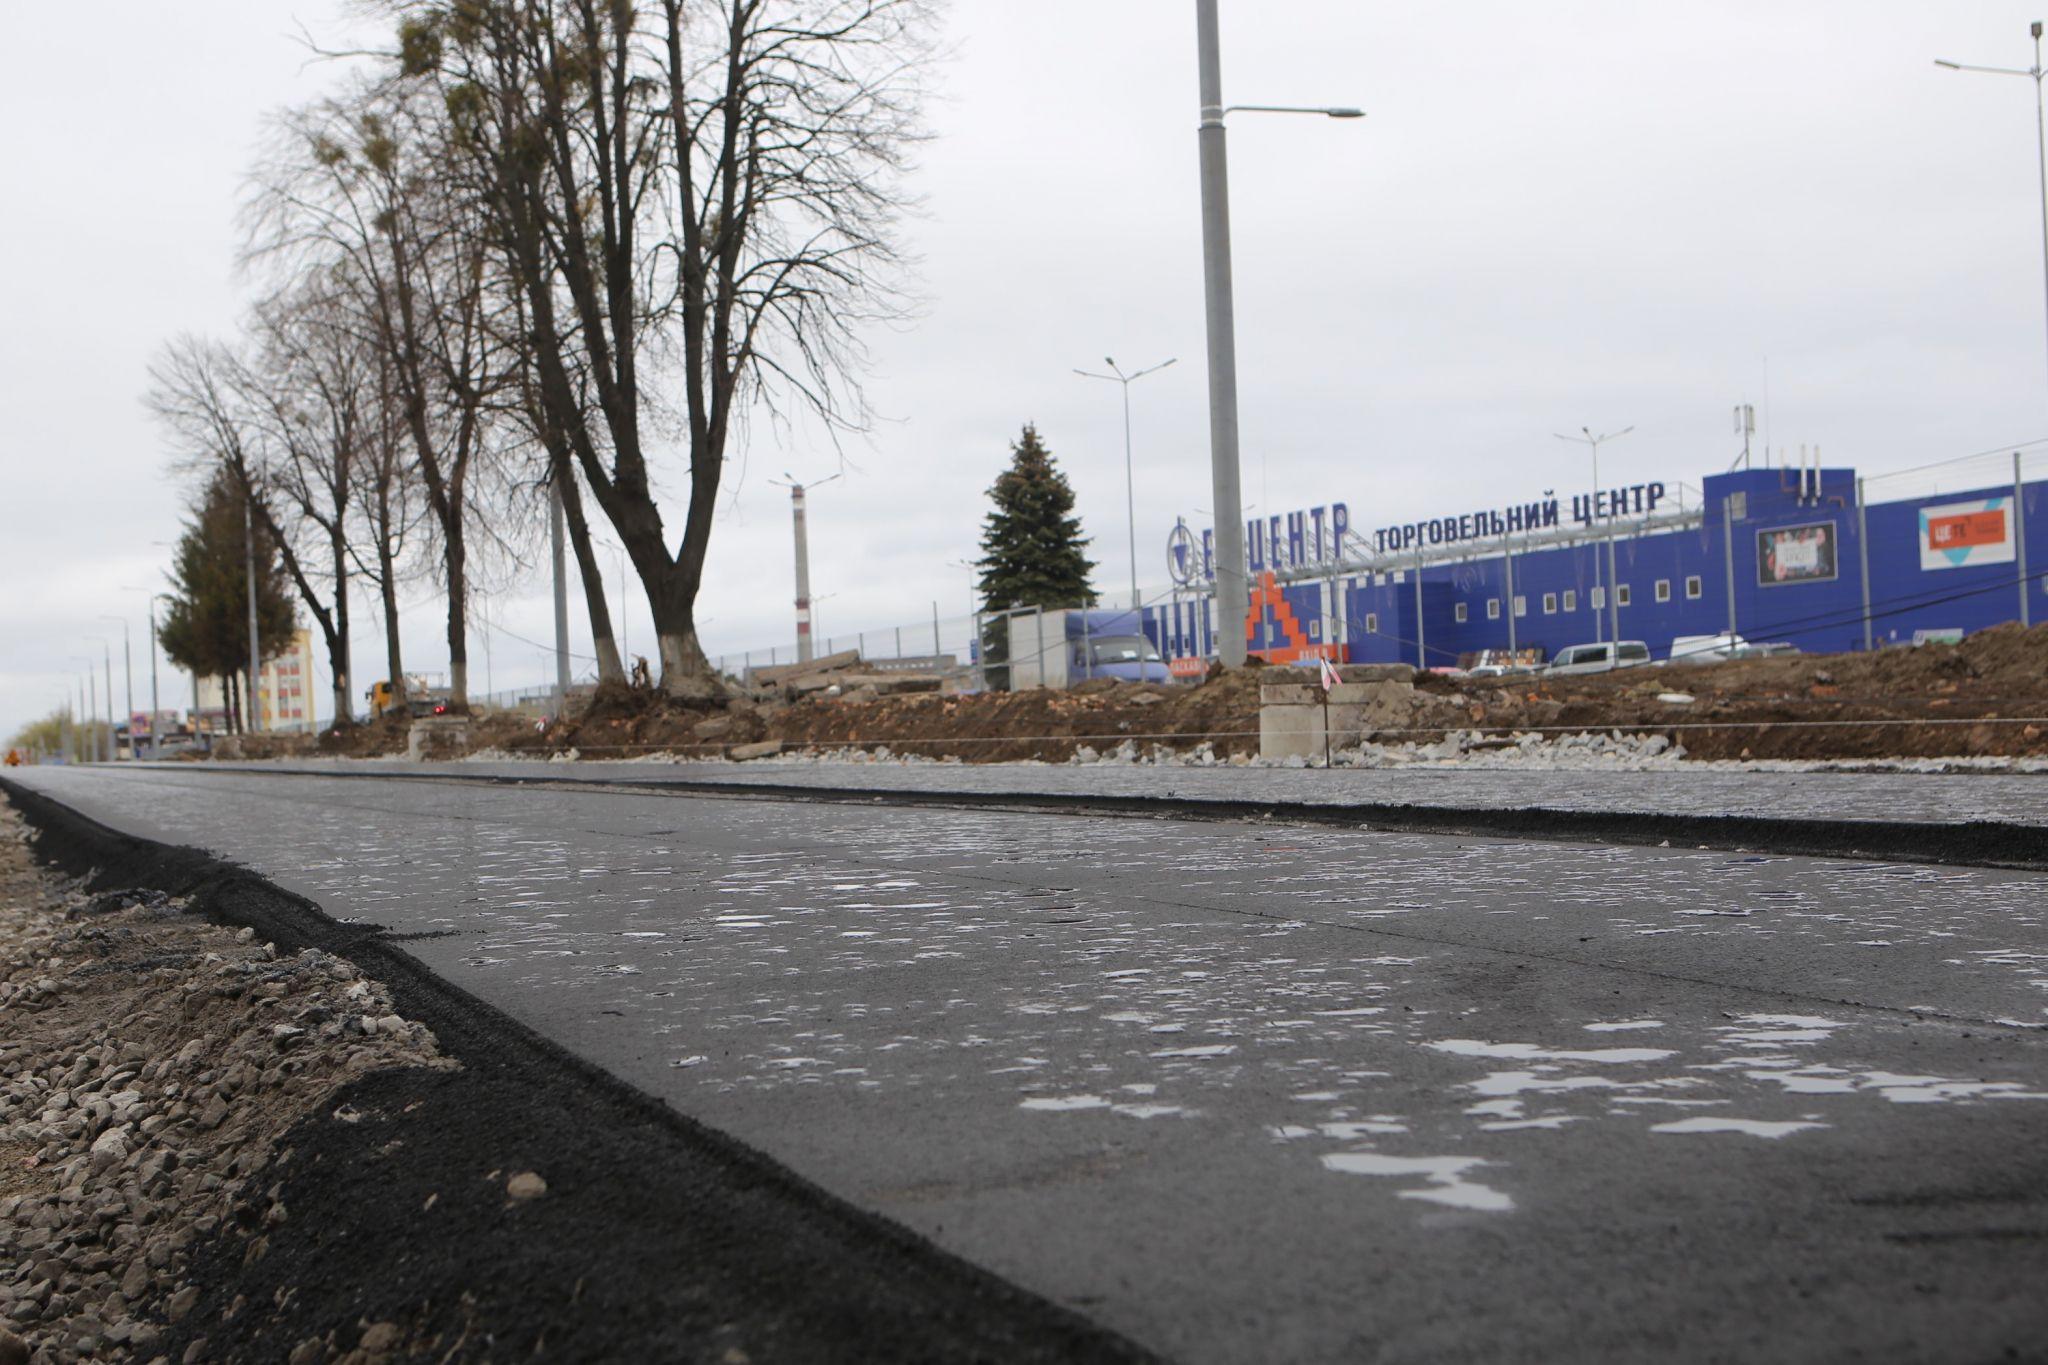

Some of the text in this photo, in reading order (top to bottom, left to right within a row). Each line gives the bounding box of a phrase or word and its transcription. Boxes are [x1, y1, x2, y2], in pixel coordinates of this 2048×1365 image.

[1202, 502, 1348, 580] ЕЦЕНТР
[1376, 482, 1665, 553] ТОРГОВЕЛЬНИЙ ЦЕНТР
